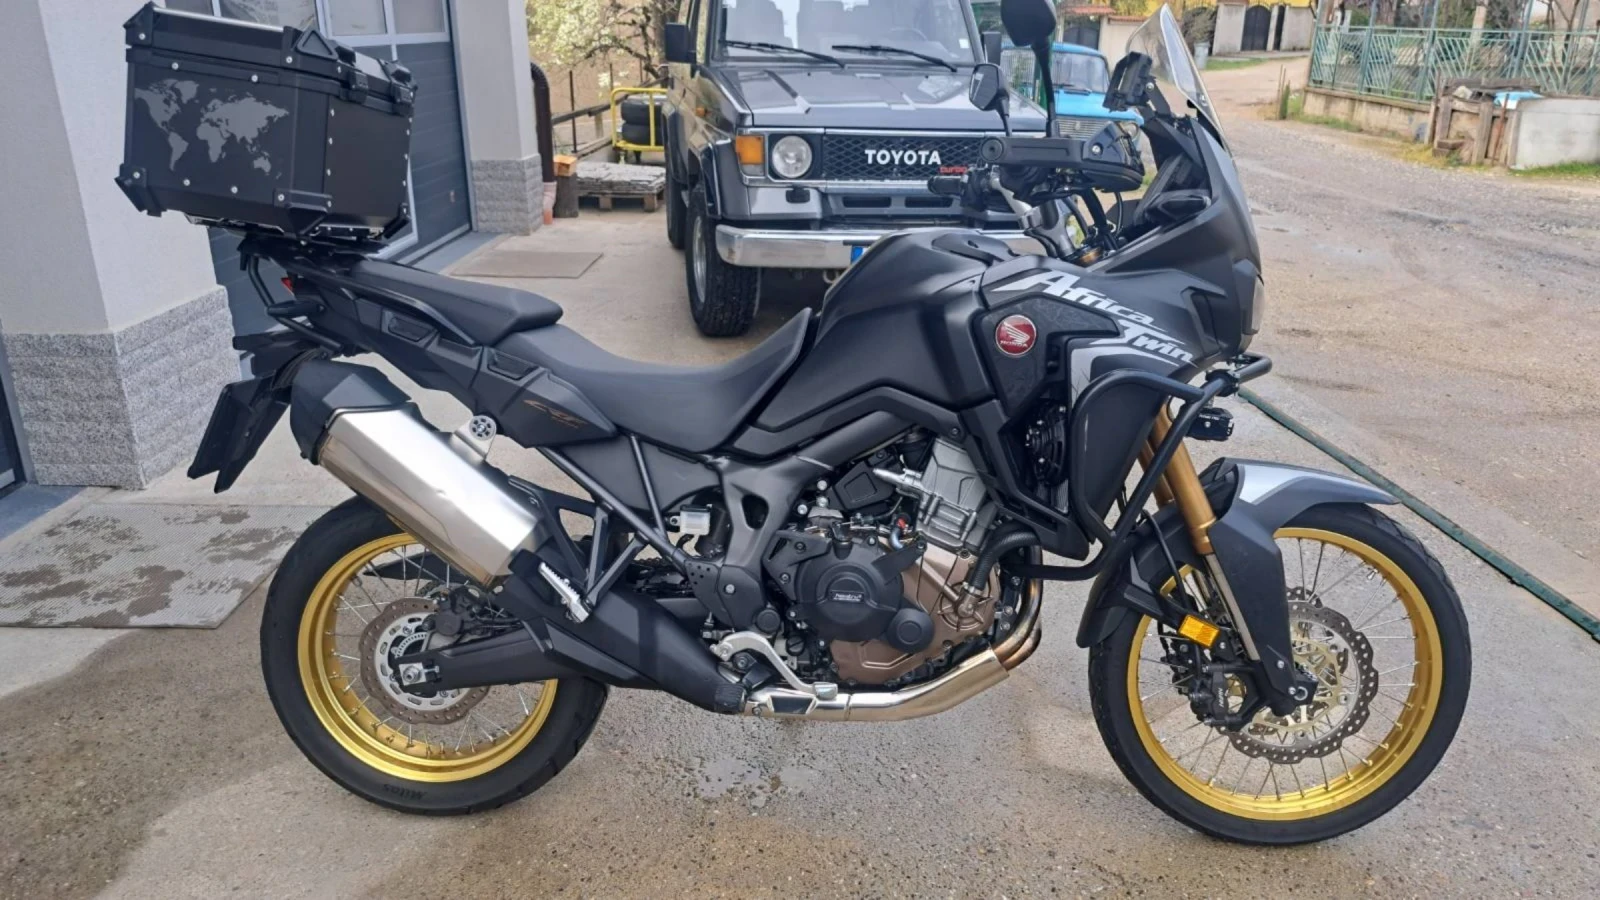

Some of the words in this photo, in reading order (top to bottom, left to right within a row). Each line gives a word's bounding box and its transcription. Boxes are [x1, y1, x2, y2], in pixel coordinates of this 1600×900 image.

[864, 149, 942, 165] TOYOTA
[990, 269, 1168, 332] Africa
[1089, 318, 1200, 369] Twin
